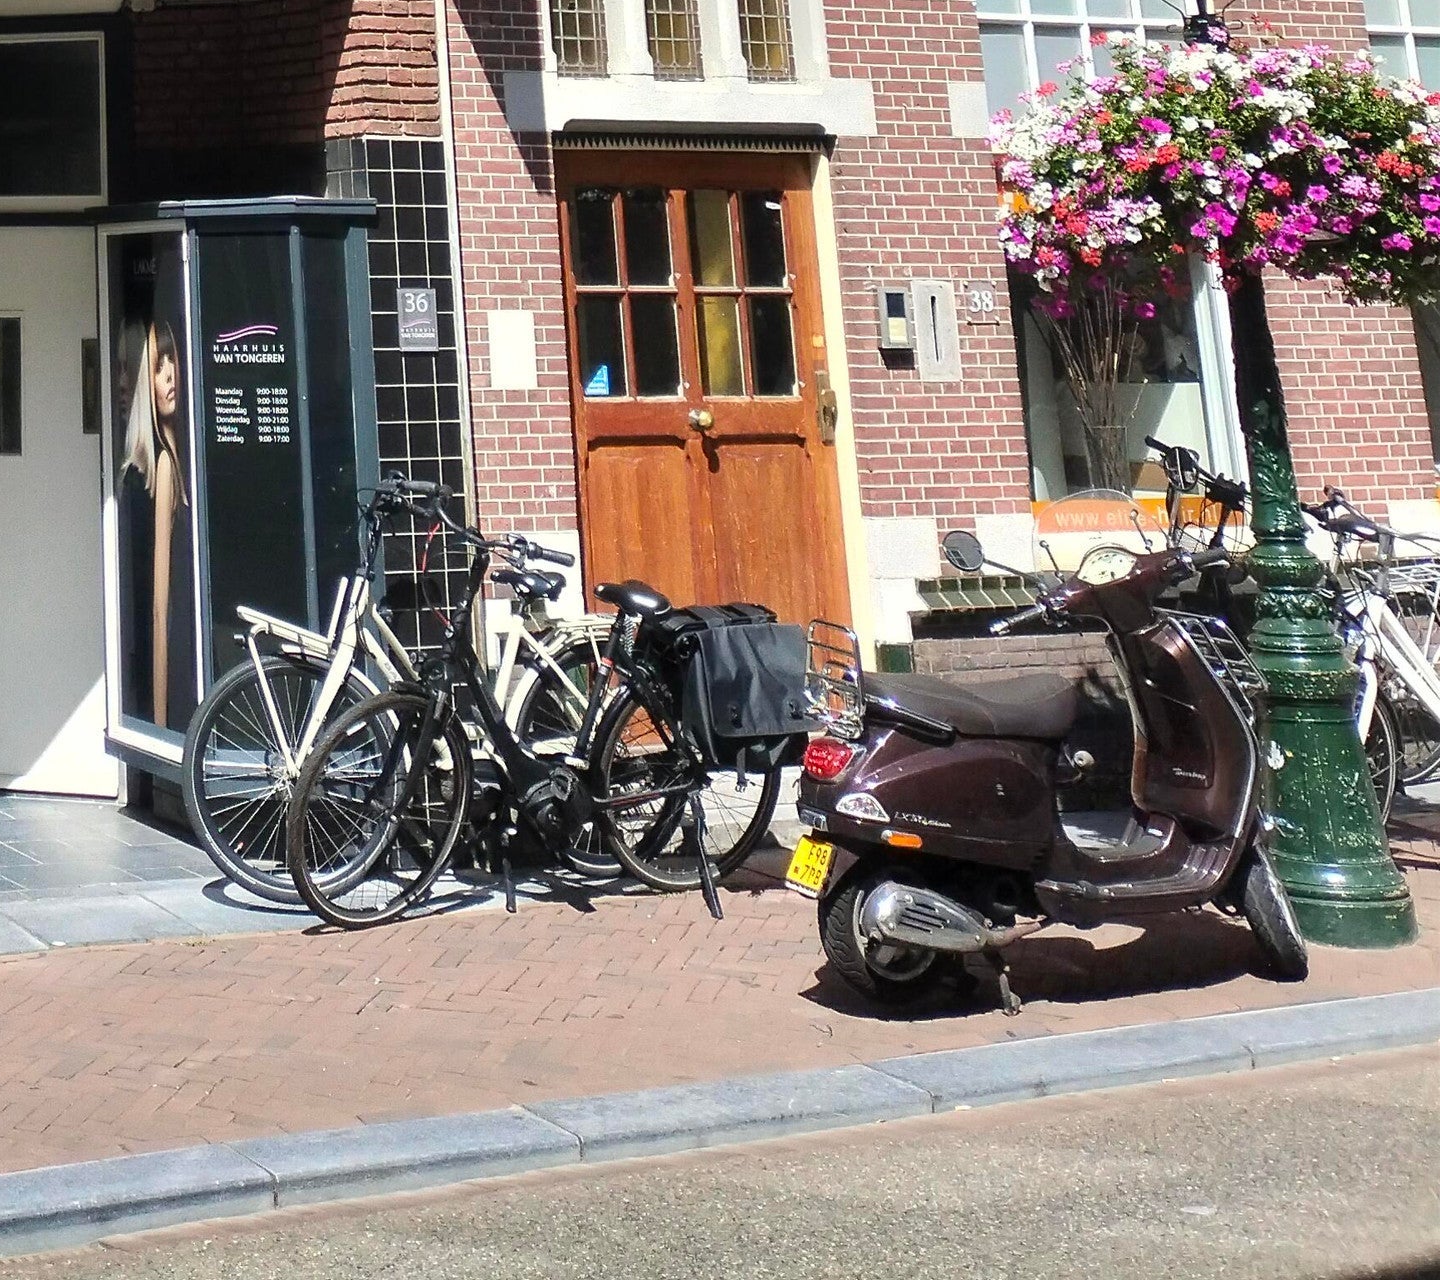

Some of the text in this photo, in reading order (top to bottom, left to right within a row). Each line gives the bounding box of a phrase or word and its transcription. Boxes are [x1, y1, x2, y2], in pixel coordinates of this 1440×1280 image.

[404, 292, 428, 313] 36
[969, 290, 994, 313] 38
[213, 344, 285, 352] HAARHUIS
[213, 353, 285, 363] VAN TONGEREN
[215, 387, 288, 397] Maandag 9:00-18:00
[215, 397, 241, 406] Dinsdag
[215, 406, 248, 415] Woensdag
[216, 416, 251, 425] Donderdag
[216, 426, 239, 434] Vrijdag
[217, 435, 245, 444] Zaterdag
[807, 844, 828, 866] F98
